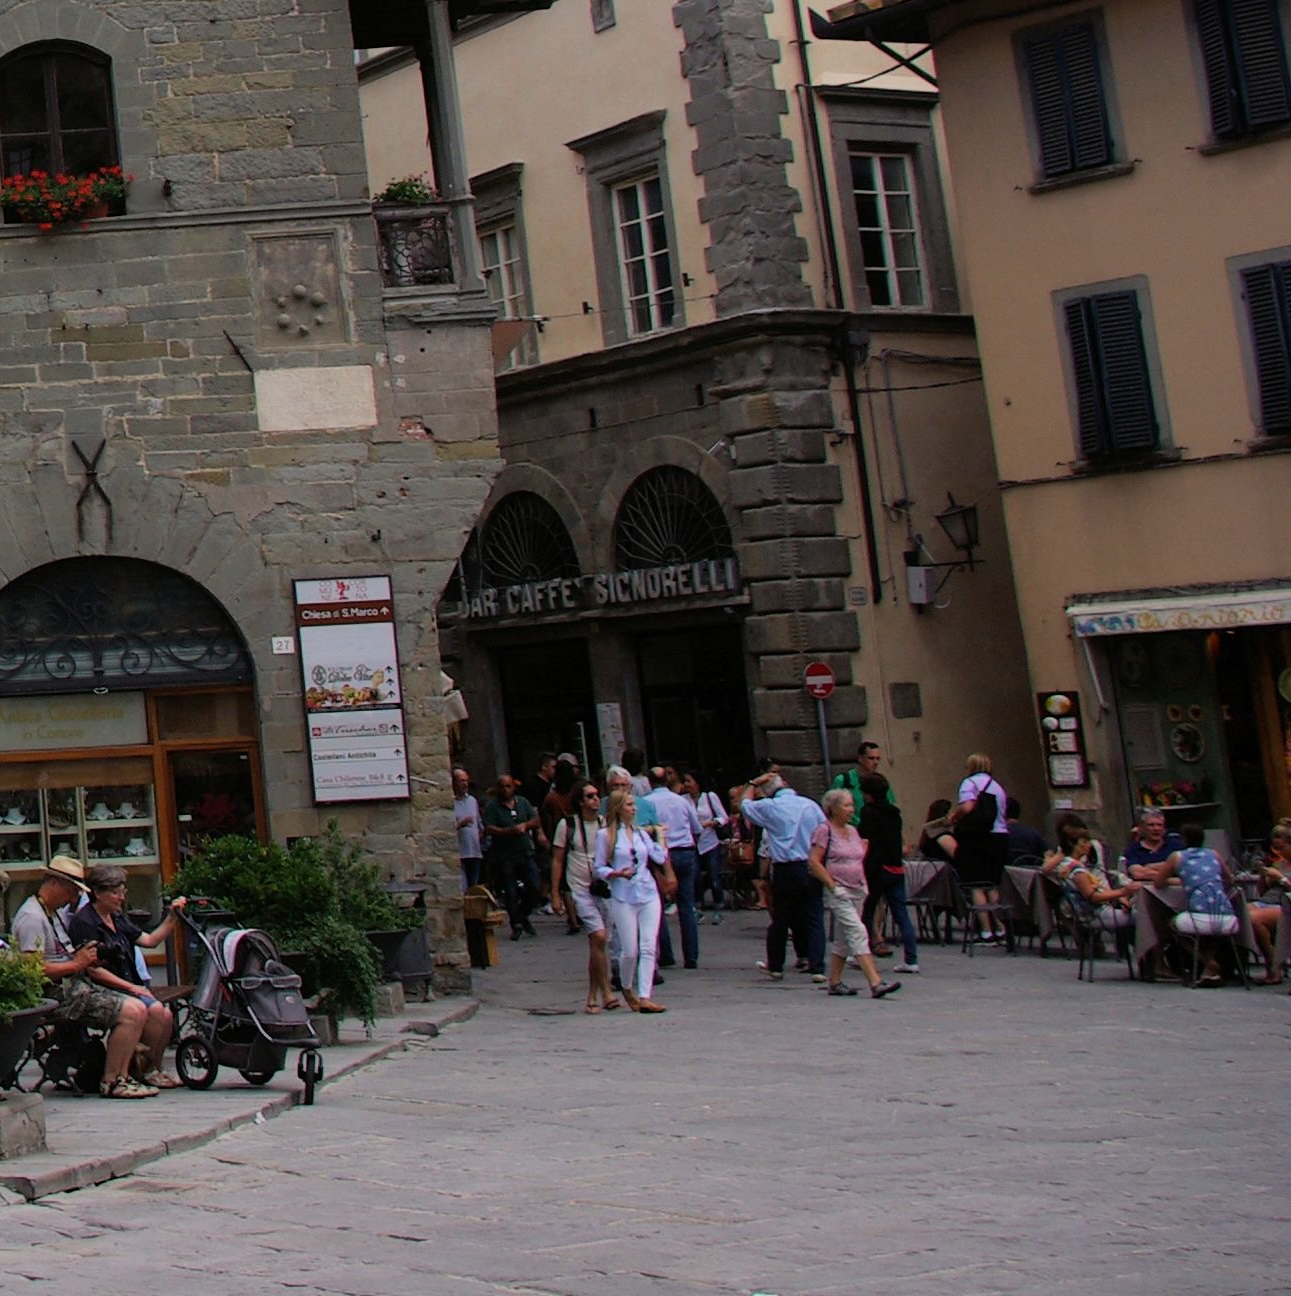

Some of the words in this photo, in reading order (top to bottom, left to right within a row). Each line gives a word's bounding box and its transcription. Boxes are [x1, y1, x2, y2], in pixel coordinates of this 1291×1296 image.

[593, 558, 736, 606] SIGNORELLI
[301, 608, 332, 620] Chiesa
[332, 609, 340, 618] di
[341, 607, 379, 618] S.Marco
[276, 640, 290, 650] 27
